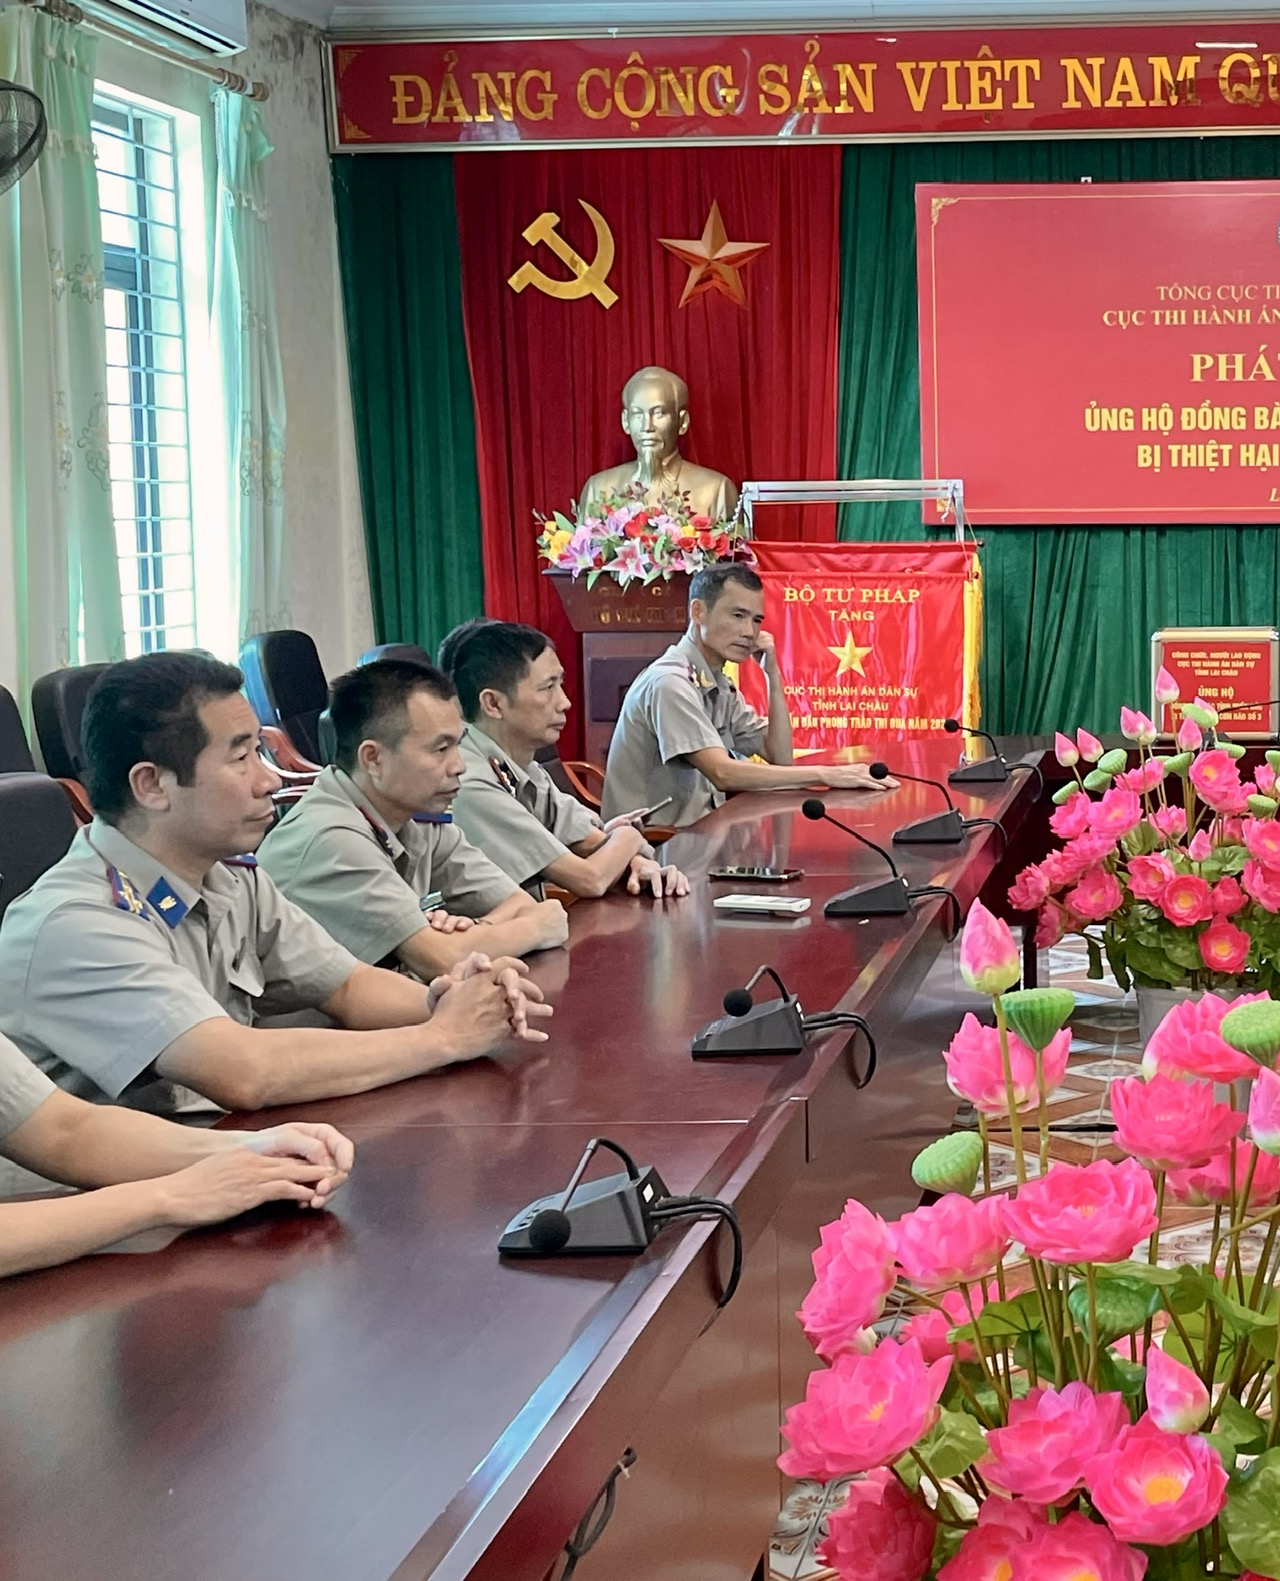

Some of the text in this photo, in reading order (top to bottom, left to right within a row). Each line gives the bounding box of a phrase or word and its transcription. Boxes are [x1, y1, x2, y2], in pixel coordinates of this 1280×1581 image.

[390, 51, 559, 124] ĐẢNG
[576, 51, 740, 132] CỘNG
[758, 40, 878, 115] SẢN
[896, 45, 1041, 123] VIỆT
[1060, 55, 1201, 109] NAM
[1156, 281, 1212, 301] TỔNG
[1216, 284, 1259, 303] CỤC
[1102, 309, 1146, 330] CỤC
[1150, 309, 1187, 326] THI
[1192, 304, 1251, 326] HÀNH
[1085, 400, 1136, 432] ỦNG
[1142, 402, 1175, 436] HỘ
[1180, 399, 1247, 432] ĐỒNG
[1136, 444, 1162, 473] BỊ
[1168, 439, 1234, 473] THIỆT
[1239, 443, 1280, 472] HẠI
[784, 583, 921, 607] BỘ TƯ PHÁP
[828, 608, 875, 624] TẶNG
[1221, 686, 1234, 700] HỘ
[839, 701, 856, 712] LAI
